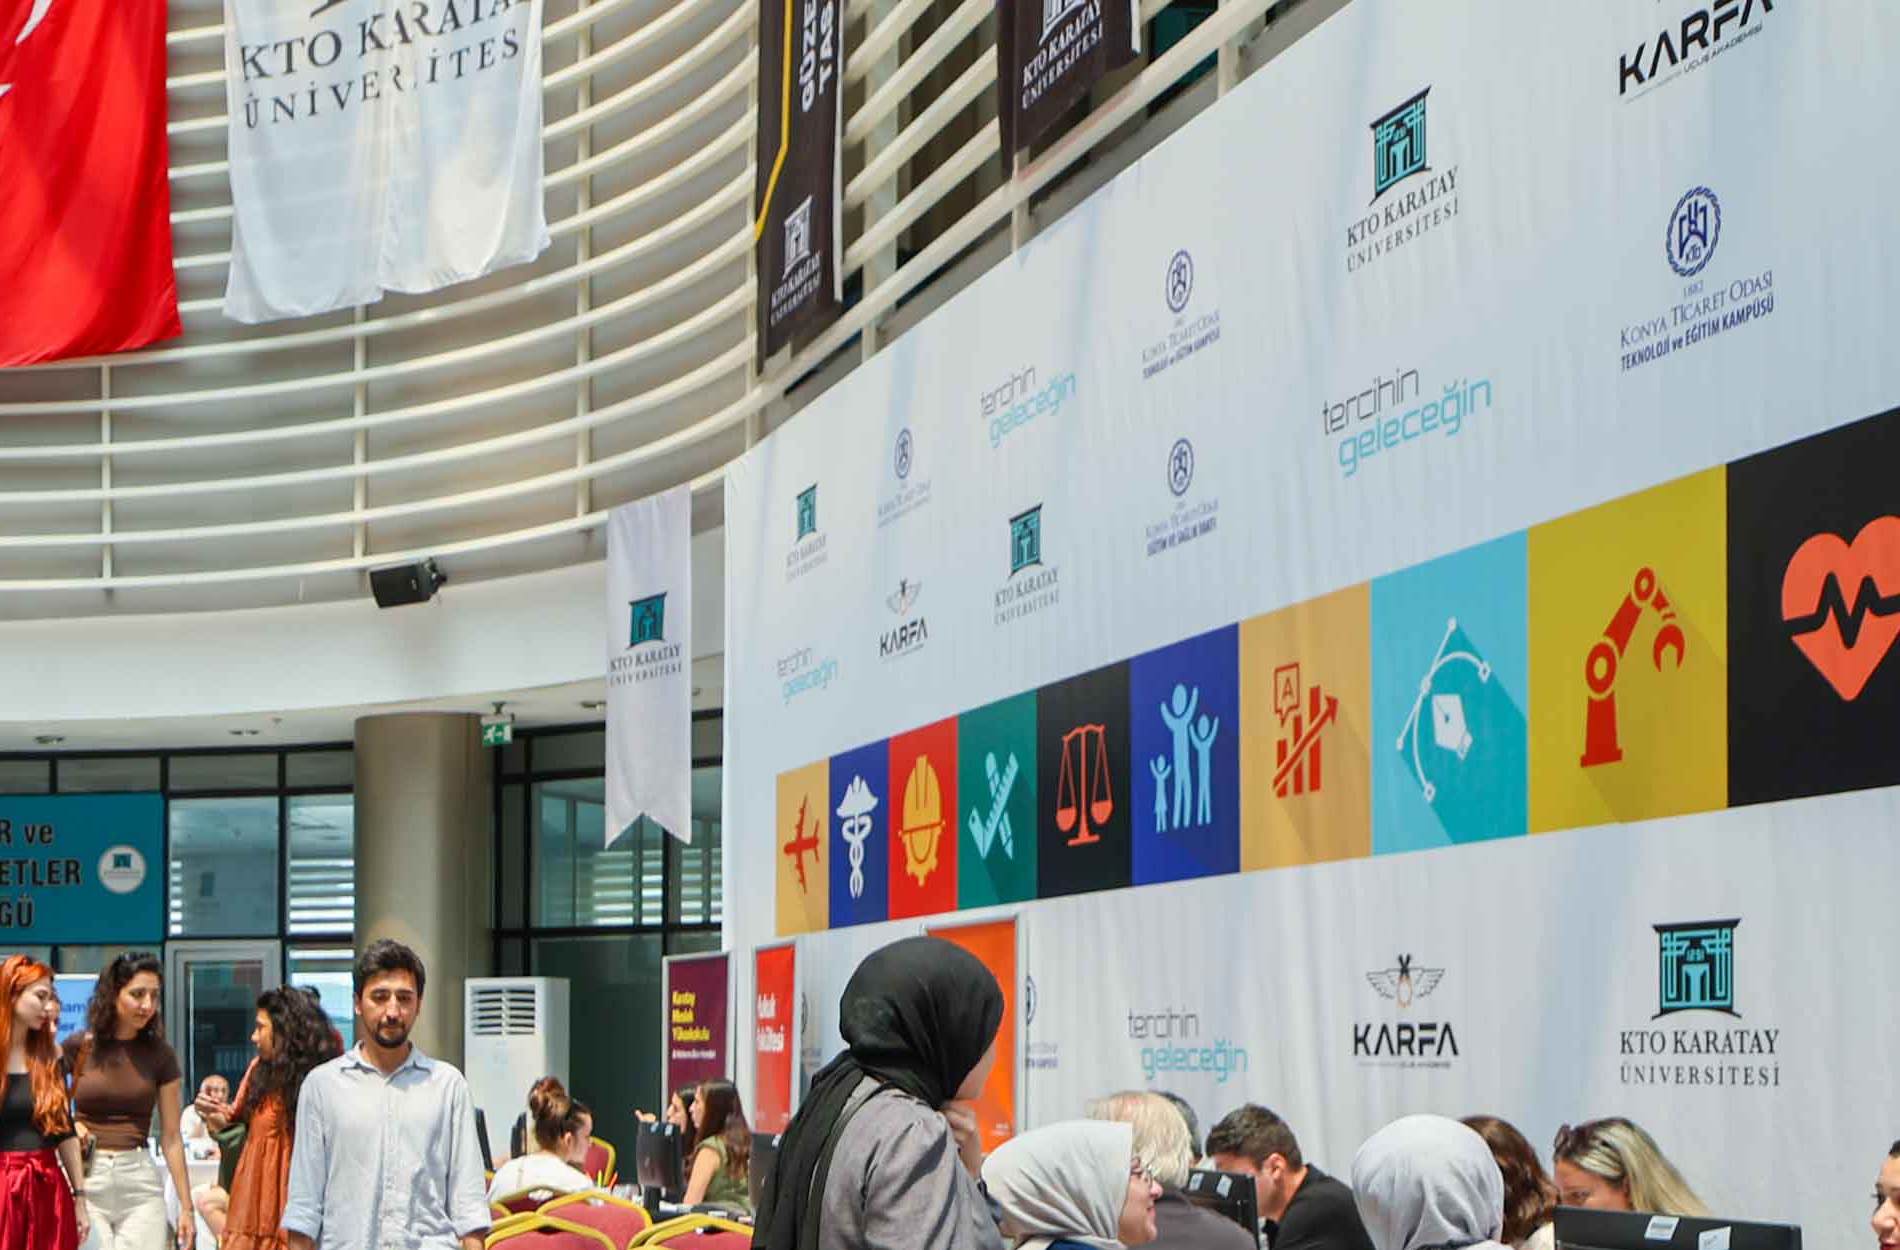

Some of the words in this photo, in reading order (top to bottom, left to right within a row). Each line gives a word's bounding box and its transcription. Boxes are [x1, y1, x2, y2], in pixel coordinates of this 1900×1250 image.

[240, 28, 342, 84] KTO
[1022, 48, 1048, 88] KTO
[1347, 212, 1381, 248] KTO
[1384, 165, 1459, 228] KARATAY
[1346, 191, 1460, 273] ÜNİVERSİTESİ
[1620, 316, 1668, 350] KONYA
[1671, 290, 1727, 327] TİCARET
[1729, 270, 1773, 302] ODASI
[1621, 335, 1670, 372] TEKNOLOJİ
[1672, 336, 1684, 352] ve
[1685, 317, 1720, 346] EĞİTİM
[1722, 292, 1775, 331] KAMPÜSÜ
[1323, 368, 1419, 436] tercihin
[1339, 378, 1492, 479] geleceğin
[879, 616, 929, 658] KARFA
[23, 822, 53, 845] ve
[1140, 1039, 1249, 1082] geleceğin
[1353, 1023, 1459, 1056] KARFA
[1620, 1030, 1667, 1054] KTO
[1673, 1028, 1780, 1054] KARATAY
[1620, 1060, 1780, 1087] ÜNİVERSİTESİ
